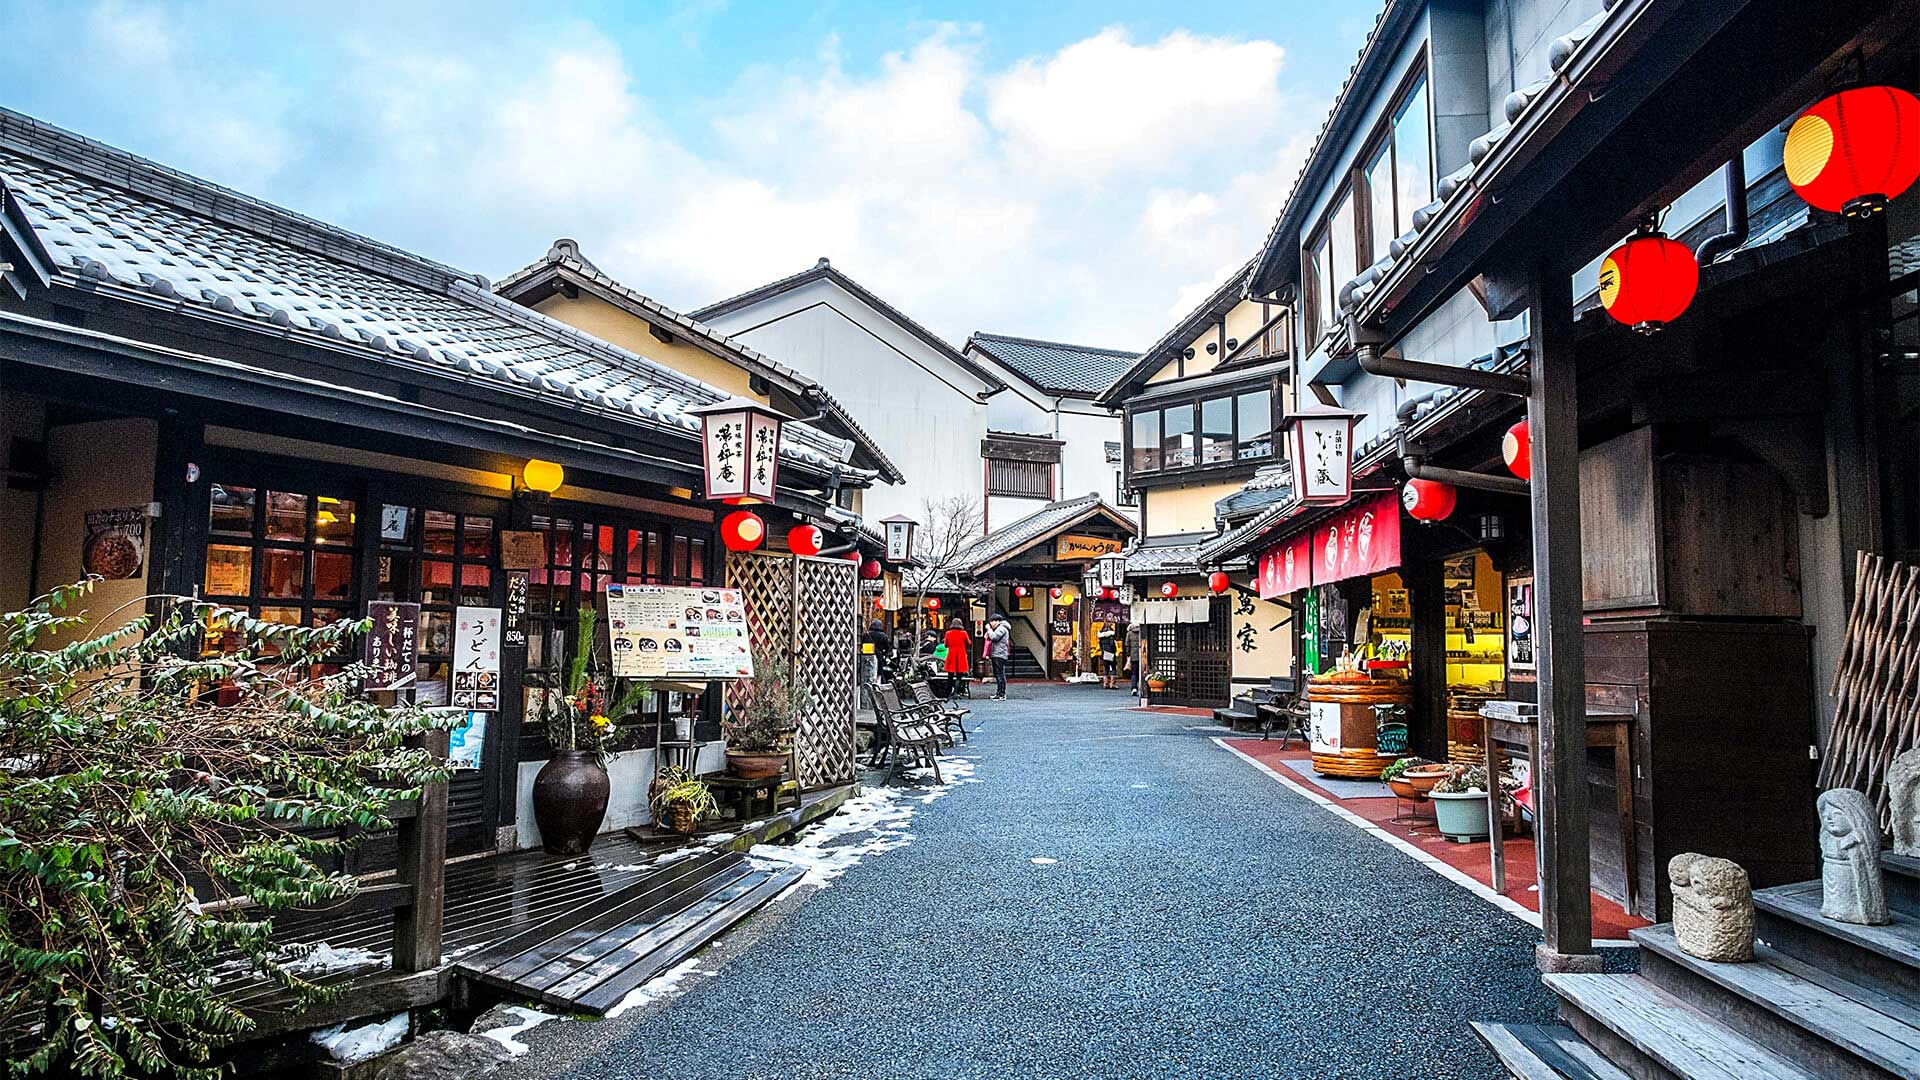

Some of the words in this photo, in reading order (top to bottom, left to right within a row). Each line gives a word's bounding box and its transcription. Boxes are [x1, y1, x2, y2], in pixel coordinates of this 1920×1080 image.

[508, 577, 519, 627] だんご汁
[382, 607, 400, 683] 美味しい珈琲
[402, 619, 414, 672] 一杯だての
[465, 620, 488, 670] うどん
